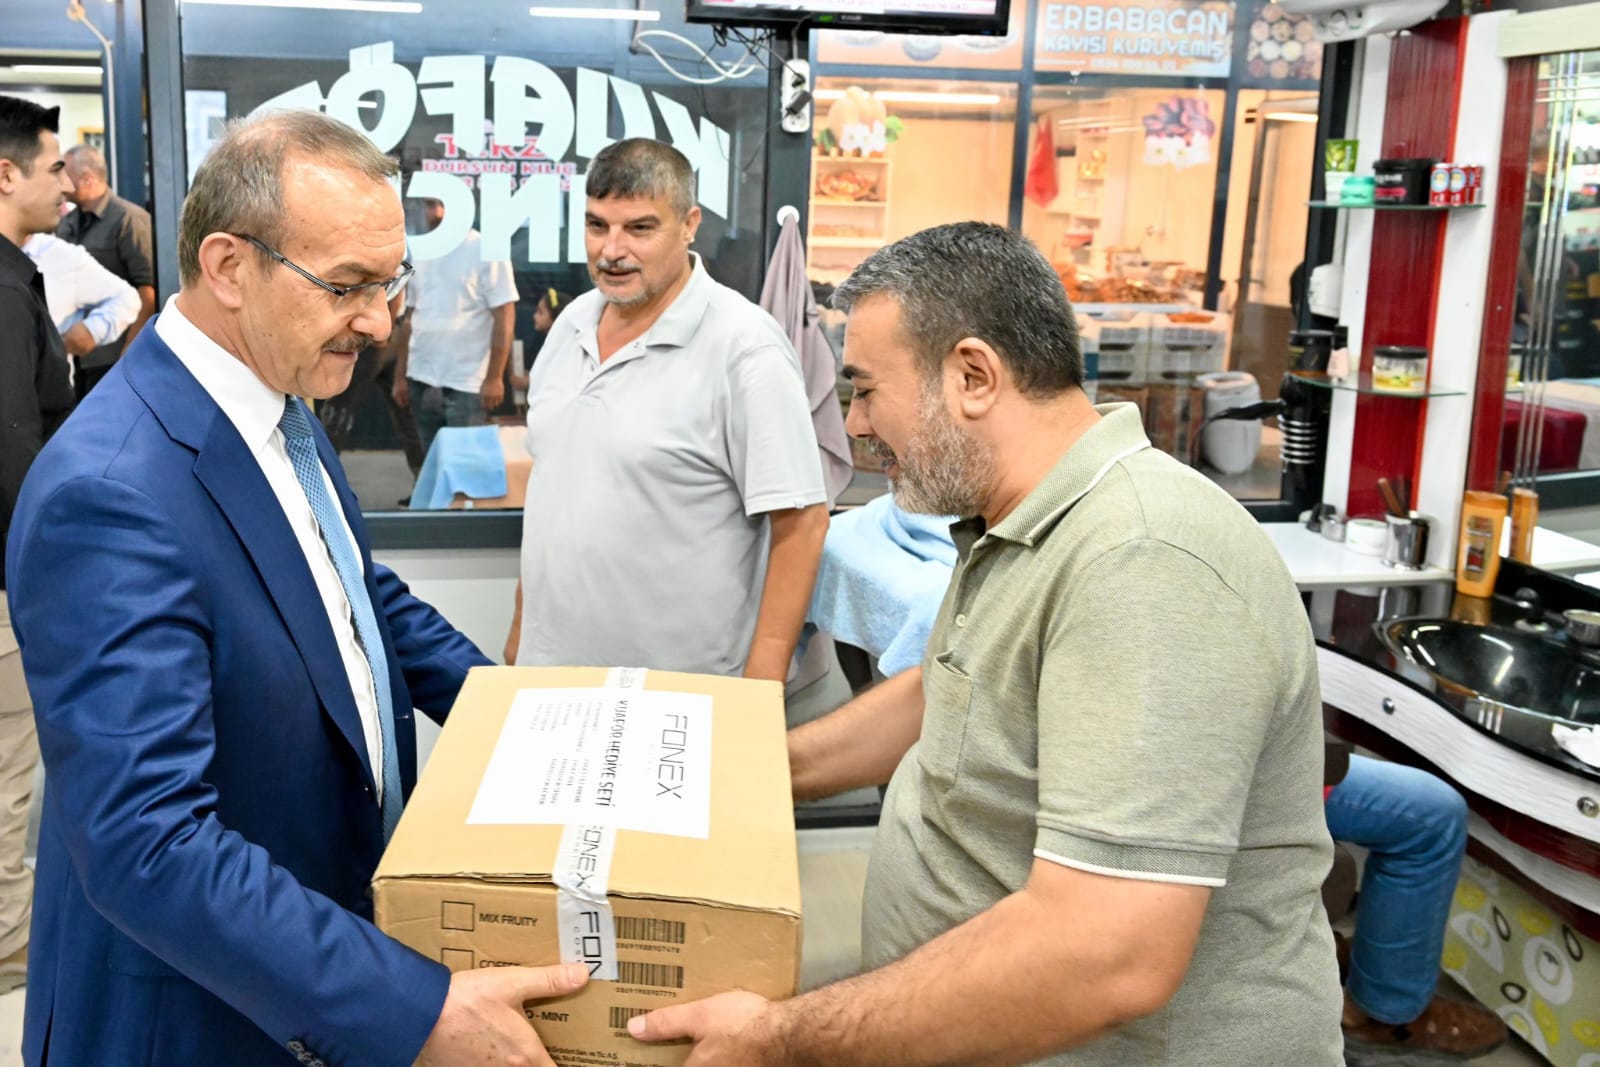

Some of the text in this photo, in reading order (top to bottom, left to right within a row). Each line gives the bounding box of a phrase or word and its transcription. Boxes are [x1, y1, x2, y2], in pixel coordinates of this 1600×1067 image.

[1044, 4, 1229, 35] ERBABACAN
[422, 159, 516, 175] DURSUN
[655, 713, 688, 800] FONEX
[479, 913, 539, 927] MIX FRUITY
[580, 911, 603, 977] FON
[541, 1011, 569, 1023] MINT
